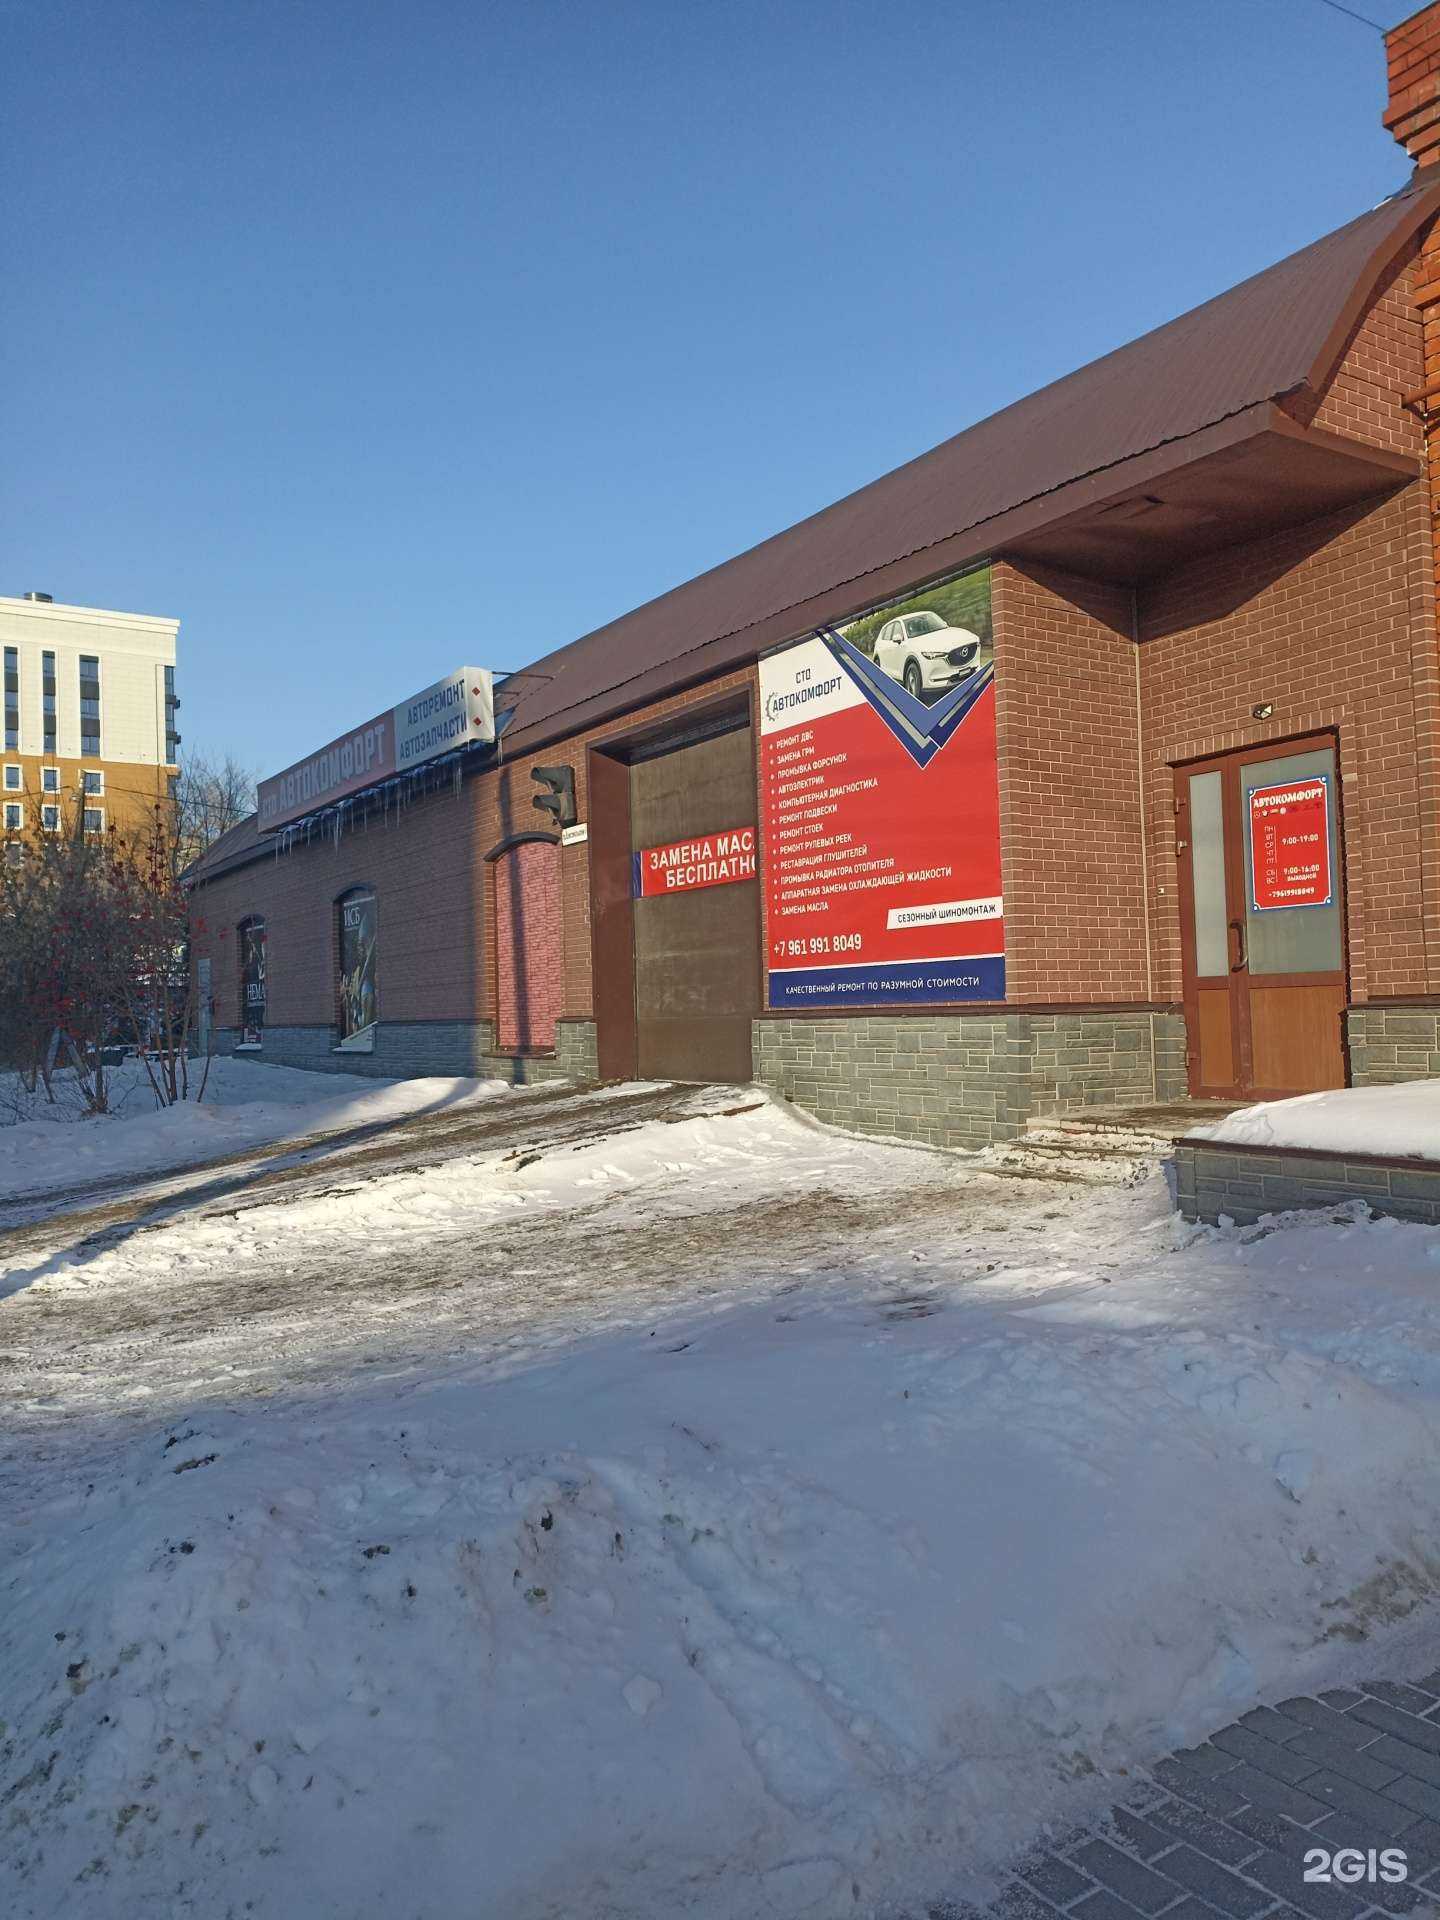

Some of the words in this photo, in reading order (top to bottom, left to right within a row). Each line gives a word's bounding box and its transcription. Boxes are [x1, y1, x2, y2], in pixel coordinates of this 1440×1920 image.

[796, 668, 811, 684] СТО
[407, 678, 465, 728] АВТОРЕМОНТ
[773, 676, 842, 712] АВТОКОМФОРТ
[400, 711, 467, 760] АВТОЗАПЧАСТИ
[776, 735, 800, 749] РЕМОНТ
[801, 730, 814, 742] ДВС
[279, 723, 385, 809] АВТОКОМФОРТ
[777, 750, 801, 765] ЗАМЕНА
[802, 746, 815, 757] ГРМ
[777, 763, 812, 779] ПРОМЫВКА
[812, 753, 848, 770] ФОРСУНОК
[778, 776, 825, 795] АВТОЭЛЕКТРИК
[779, 790, 829, 809] КОМПЬЮТЕРНАЯ
[829, 777, 878, 797] ДИАГНОСТИКА
[1253, 788, 1323, 808] АВТОКОМФОРТ
[779, 811, 803, 825] РЕМОНТ
[803, 804, 838, 819] ПОДВЕСКИ
[779, 827, 803, 840] РЕМОНТ
[804, 822, 824, 835] СТОЕК
[650, 841, 713, 870] ЗАМЕНА
[717, 832, 755, 857] МАС
[780, 842, 804, 855] РЕМОНТ
[804, 836, 835, 850] РУЛЕВЫХ
[835, 833, 852, 844] РЕЕК
[780, 855, 823, 870] РЕСТАВРАЦИЯ
[823, 844, 868, 862] ГЛУШИТЕЛЕЙ
[781, 873, 815, 885] ПРОМЫВКА
[815, 866, 853, 880] РАДИАТОРА
[853, 858, 894, 873] ОТОПИТЕЛЯ
[781, 887, 821, 901] АППАРАТНАЯ
[821, 882, 848, 895] ЗАМЕНА
[848, 871, 904, 891] ОХЛАЖДАЮЩЕЙ
[906, 867, 952, 883] ЖИДКОСТИ
[781, 904, 806, 915] ЗАМЕНА
[806, 901, 829, 912] МАСЛА
[897, 908, 937, 924] СЕЗОННЫЙ
[938, 904, 996, 919] ШИНОМОНТАЖ
[774, 940, 786, 957] +7
[788, 937, 807, 956] 961
[810, 936, 830, 954] 991
[833, 933, 862, 951] 8049
[785, 980, 835, 994] КАЧЕСТВЕННЫЙ
[837, 981, 865, 992] РЕМОНТ
[867, 980, 879, 991] ПО
[881, 976, 924, 990] РАЗУМНОЙ
[926, 976, 980, 988] СТОИМОСТИ
